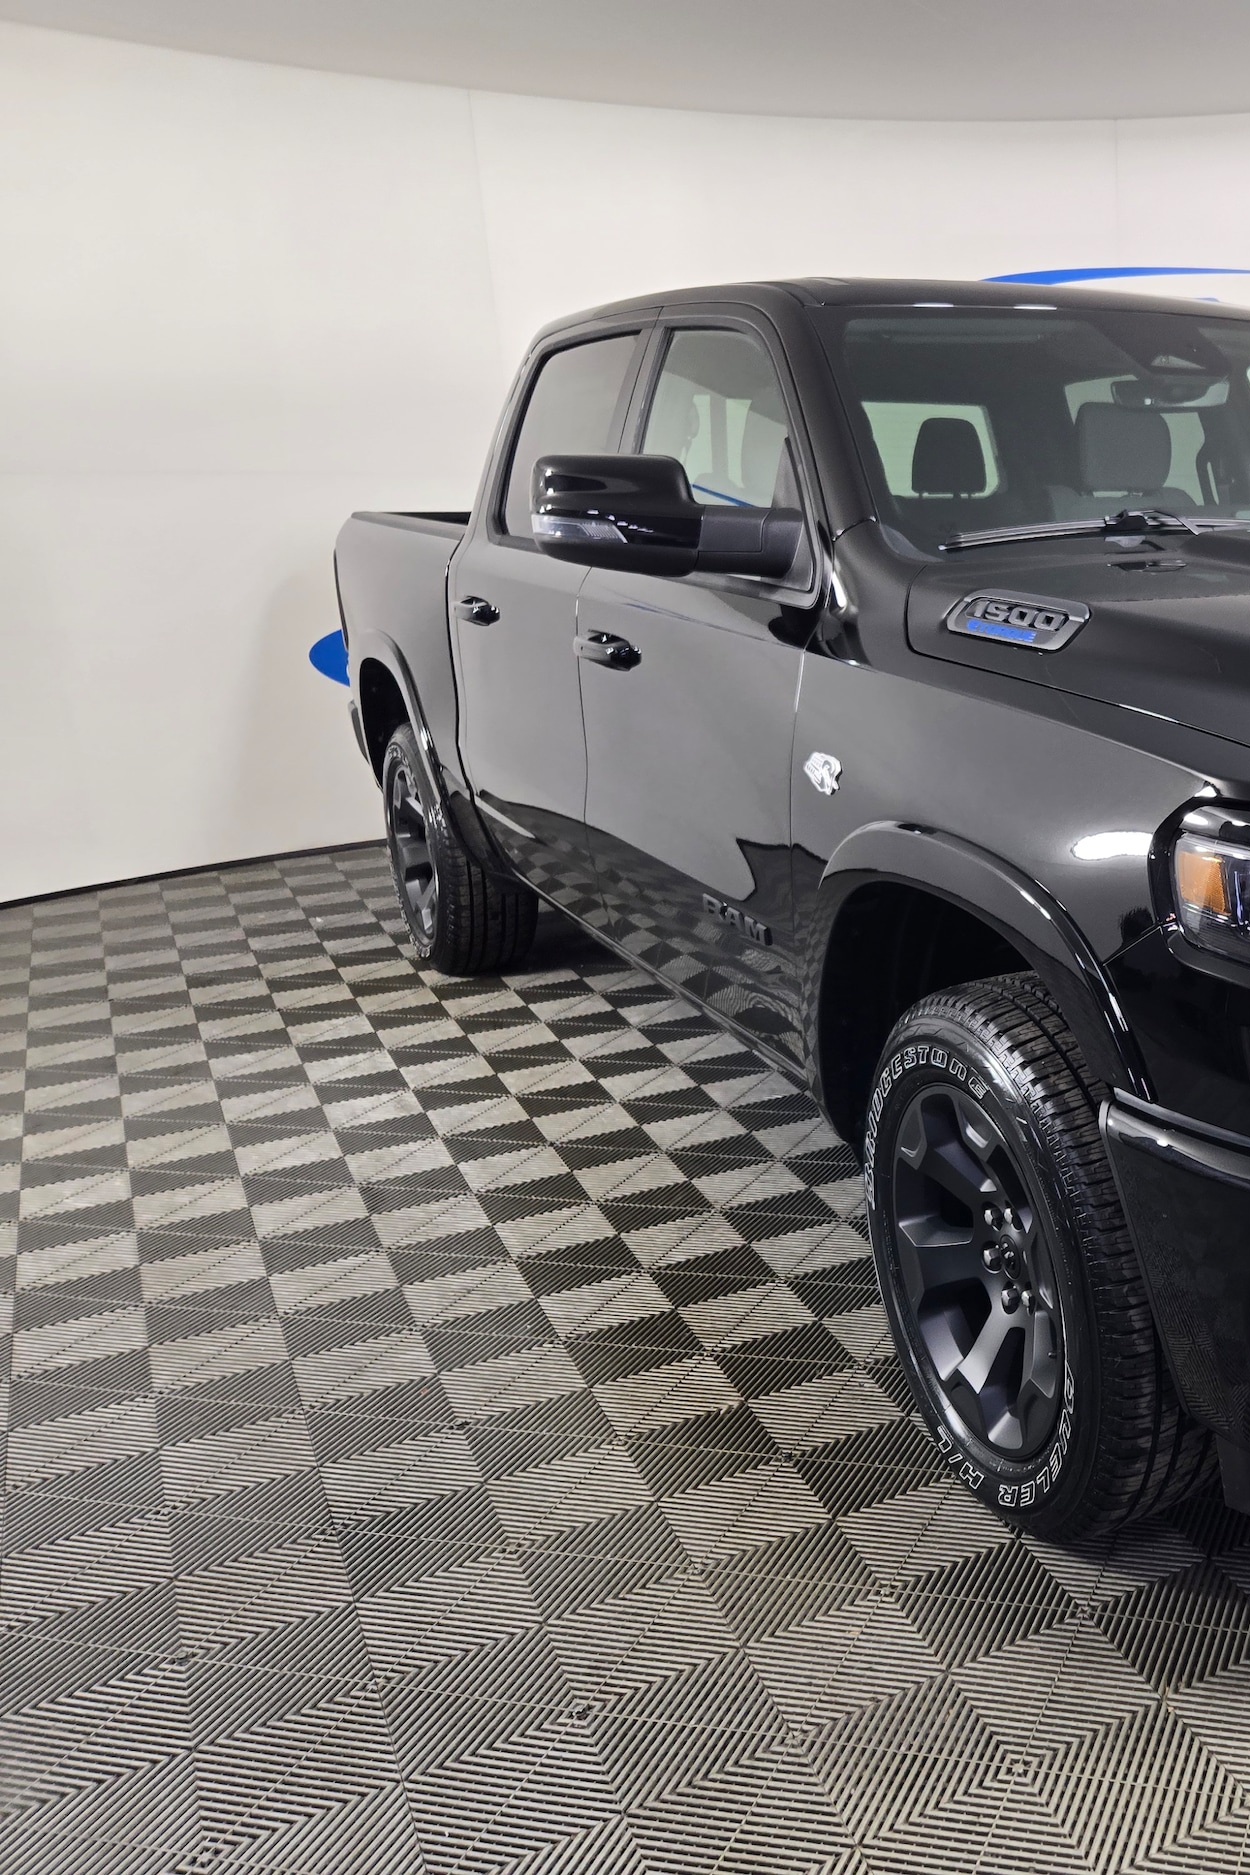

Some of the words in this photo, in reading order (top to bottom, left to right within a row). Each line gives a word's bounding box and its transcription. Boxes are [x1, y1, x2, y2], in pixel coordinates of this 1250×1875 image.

[971, 600, 1066, 631] 1500
[702, 893, 773, 946] RAM
[864, 1045, 989, 1211] BRIDGESTONE
[998, 1360, 1075, 1507] DUELER
